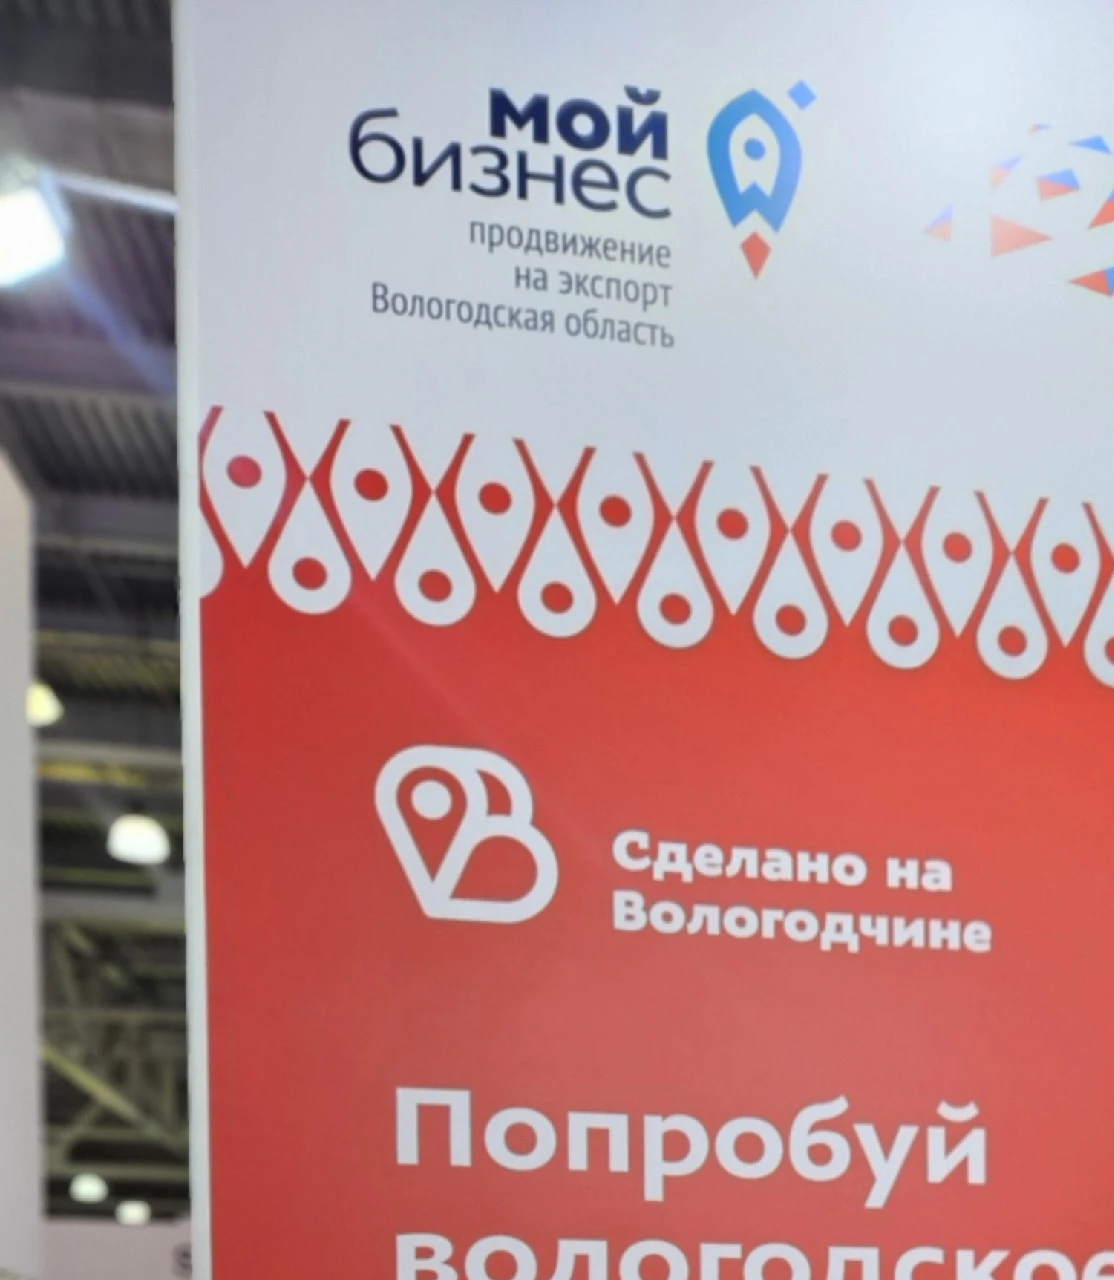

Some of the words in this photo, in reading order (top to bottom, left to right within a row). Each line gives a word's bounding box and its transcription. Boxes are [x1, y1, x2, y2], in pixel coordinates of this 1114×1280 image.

[488, 84, 669, 161] мой
[348, 107, 672, 220] бизнес
[468, 219, 672, 269] продвижение
[372, 282, 555, 335] Вологодская
[564, 309, 675, 349] область
[513, 262, 549, 292] на
[557, 270, 673, 309] экспорт
[612, 828, 868, 886] Сделано
[886, 856, 953, 893] на
[612, 890, 993, 953] Вологодчине
[395, 1086, 988, 1209] Попробуй
